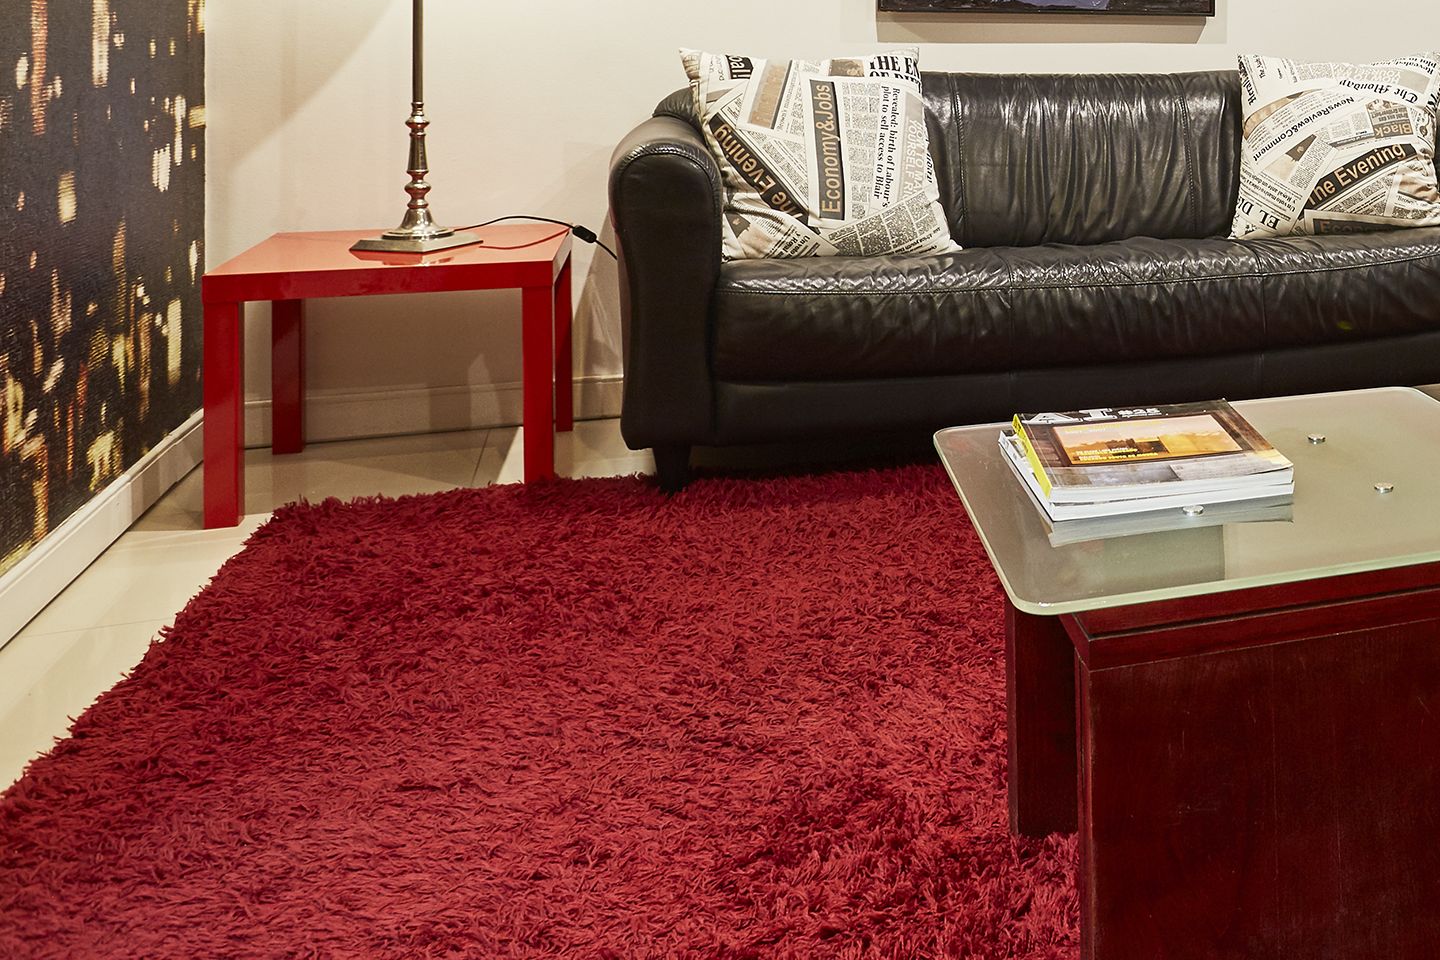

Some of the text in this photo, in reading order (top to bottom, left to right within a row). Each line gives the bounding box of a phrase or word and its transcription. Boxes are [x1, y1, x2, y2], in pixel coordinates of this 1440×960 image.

[1393, 88, 1418, 103] The
[713, 123, 777, 196] Evening
[813, 84, 841, 214] Economy&Jobs
[872, 86, 892, 200] plot to sell access to Blair
[881, 87, 901, 208] Revealed: birth of Labour's
[904, 119, 917, 179] YOURSELF
[1252, 96, 1355, 162] NewsReview&Comment
[1374, 124, 1413, 137] Black
[1333, 143, 1406, 185] Evening
[1259, 209, 1280, 230] EL
